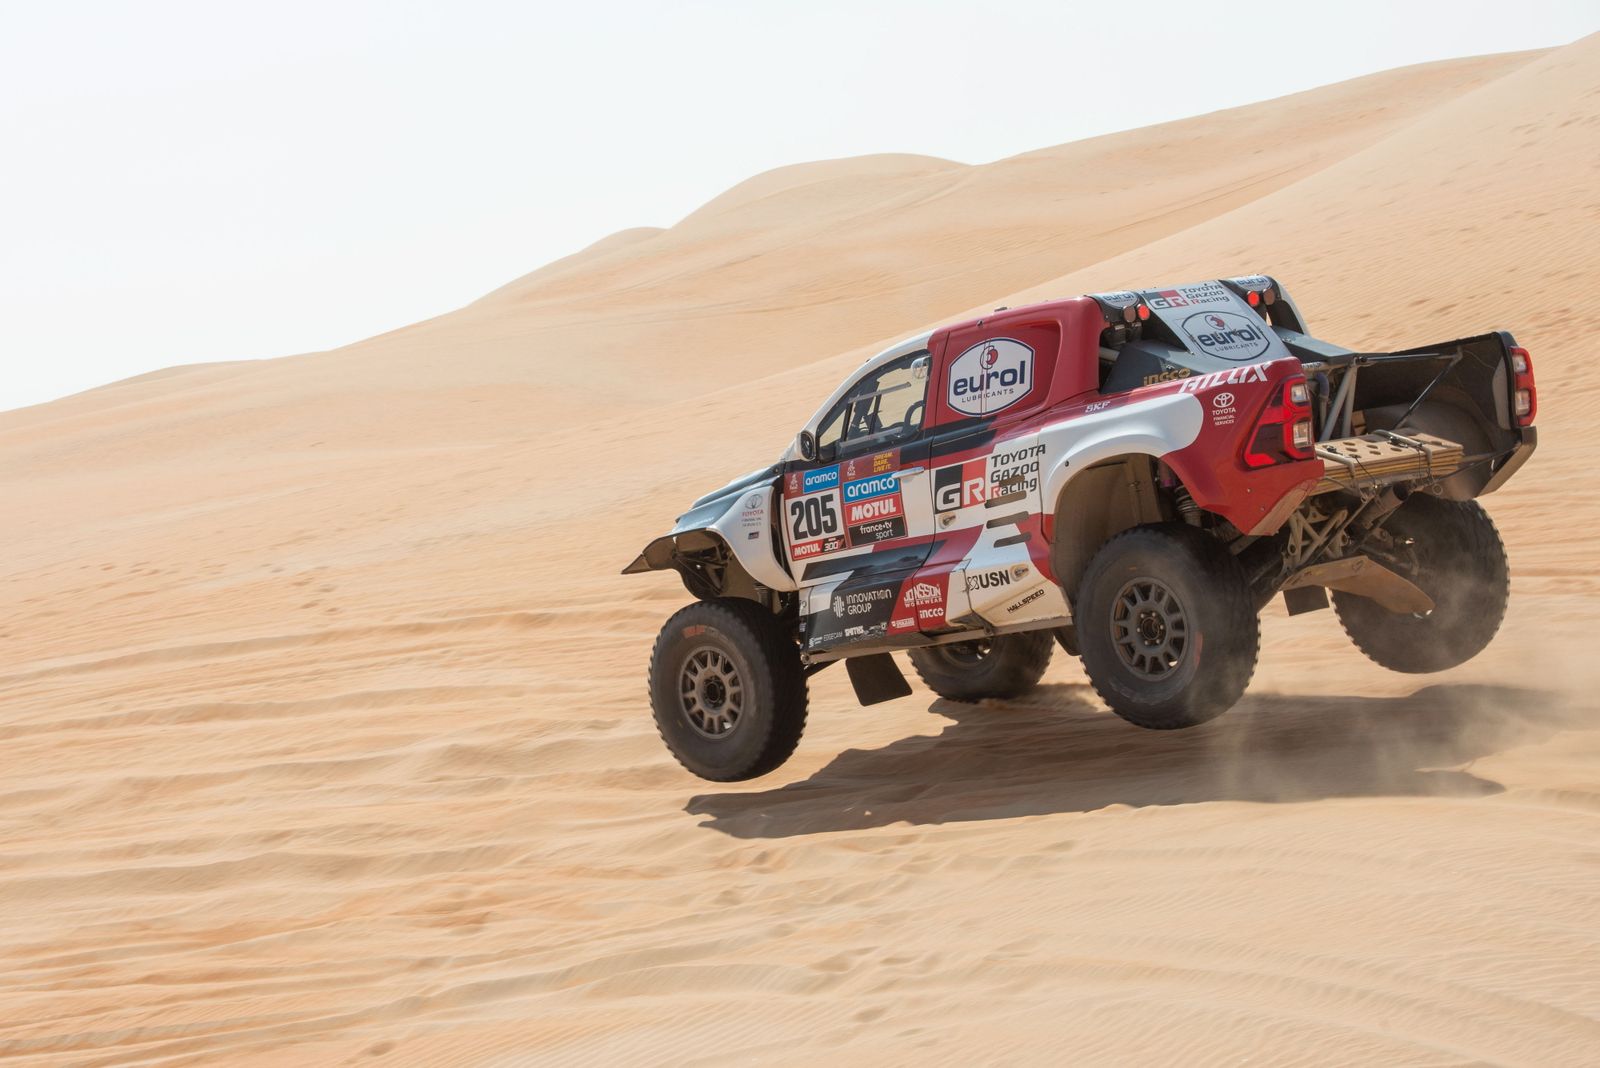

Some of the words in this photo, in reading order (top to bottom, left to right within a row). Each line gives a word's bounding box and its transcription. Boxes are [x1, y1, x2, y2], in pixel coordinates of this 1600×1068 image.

[1180, 284, 1223, 294] TOYOTA
[1186, 290, 1224, 299] GAZOO
[1149, 296, 1189, 309] GR
[1191, 295, 1230, 305] Racing
[1197, 324, 1262, 347] eurol
[1215, 342, 1259, 352] LUBRICANTS
[953, 360, 1026, 396] eurol
[961, 388, 1015, 403] LUBRICANTS
[1211, 407, 1236, 416] TOYOTA
[991, 444, 1046, 468] TOYOTA
[805, 471, 837, 486] aramco
[991, 461, 1039, 483] GAZOO
[847, 477, 895, 497] aramco
[936, 477, 985, 511] GR
[990, 478, 1037, 500] Racing
[790, 493, 838, 540] 205
[851, 498, 896, 521] MOTUL
[876, 529, 893, 541] sport
[794, 543, 821, 556] MOTUL
[979, 570, 1010, 589] USN
[846, 588, 892, 604] INNOVATION
[904, 583, 941, 601] JONSSON
[848, 603, 872, 615] GROUP
[905, 597, 942, 608] WORKWEAR
[1007, 589, 1045, 613] HALLSPEED
